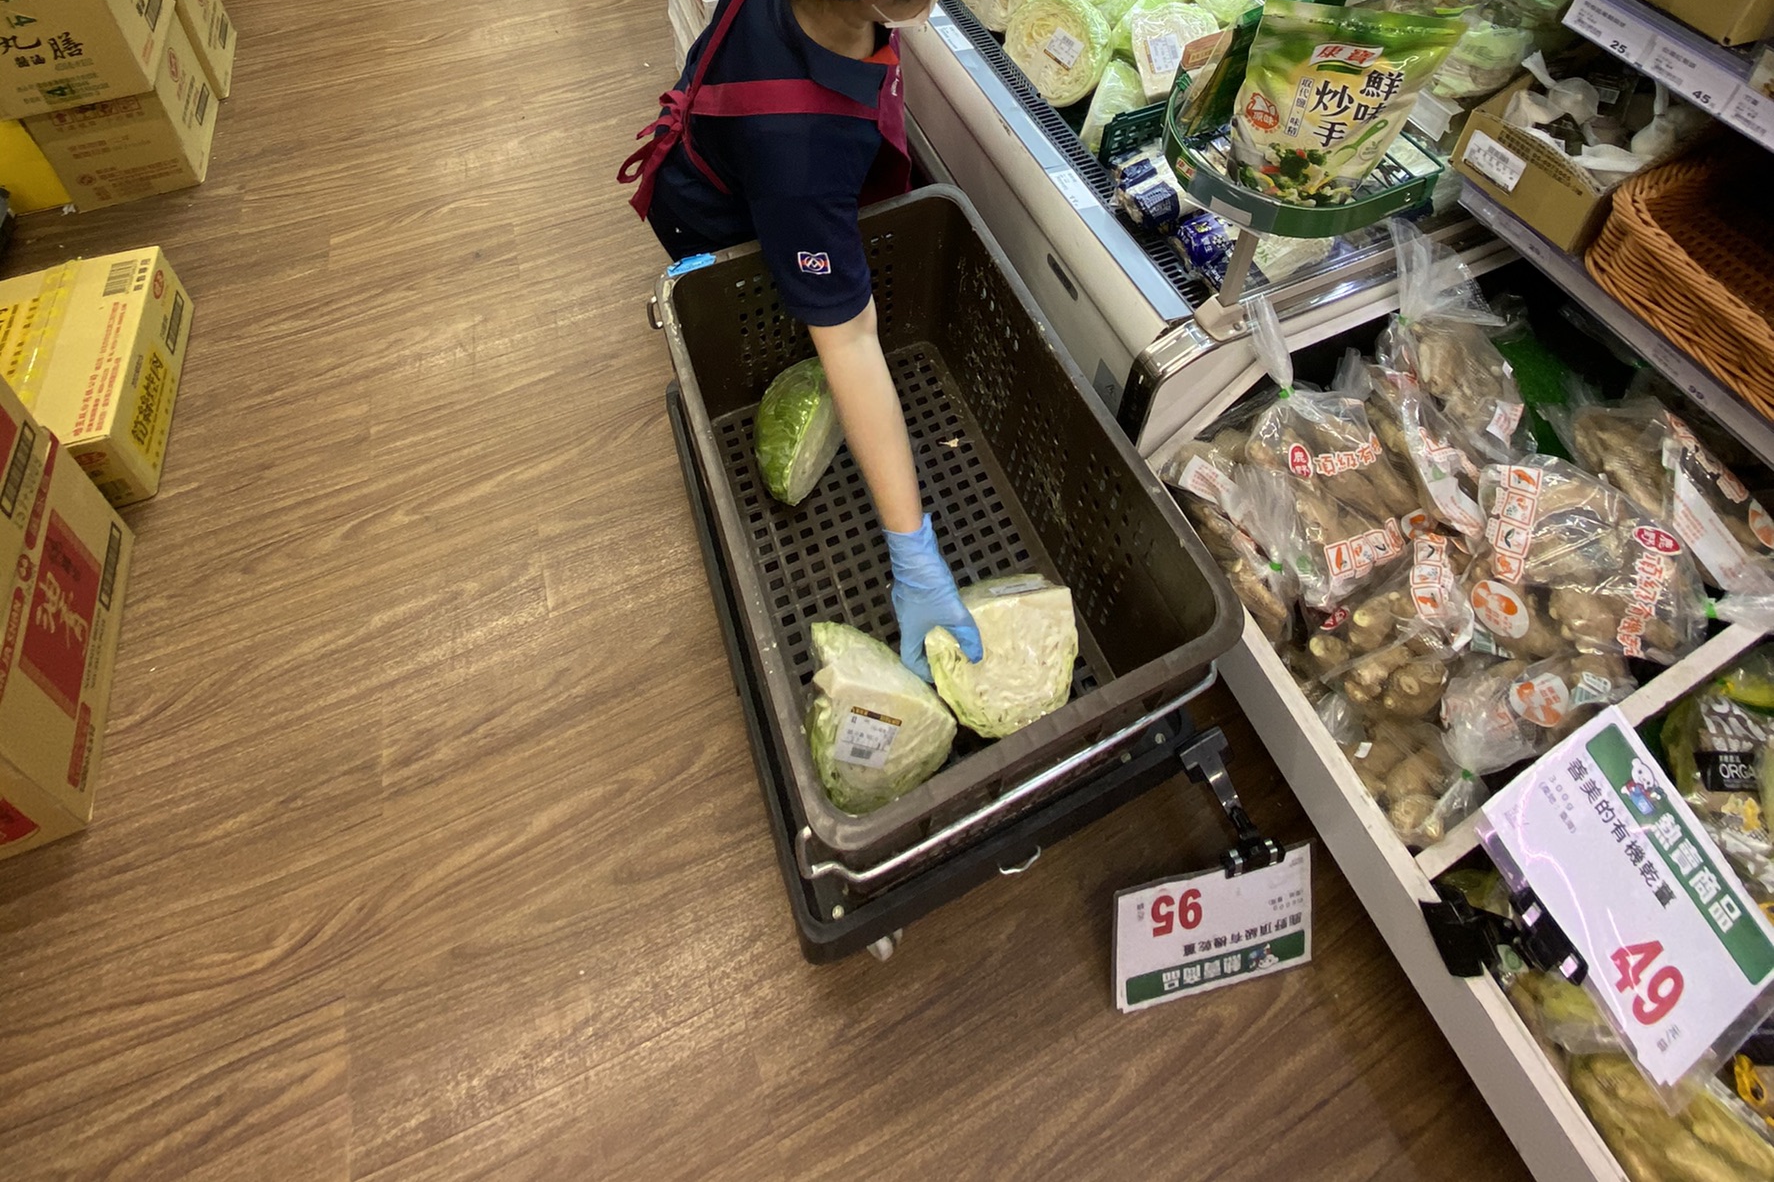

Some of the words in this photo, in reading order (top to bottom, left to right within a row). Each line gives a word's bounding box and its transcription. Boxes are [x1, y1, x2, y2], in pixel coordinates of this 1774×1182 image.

[1316, 45, 1376, 65] 康寶
[1609, 39, 1627, 55] 25
[1691, 90, 1712, 105] 45
[1567, 757, 1677, 910] 善美的有機乾薑
[1647, 811, 1744, 935] 熱賣商品
[1150, 888, 1204, 937] 95
[1162, 951, 1242, 989] 熱賣商品
[1609, 939, 1685, 1026] 49
